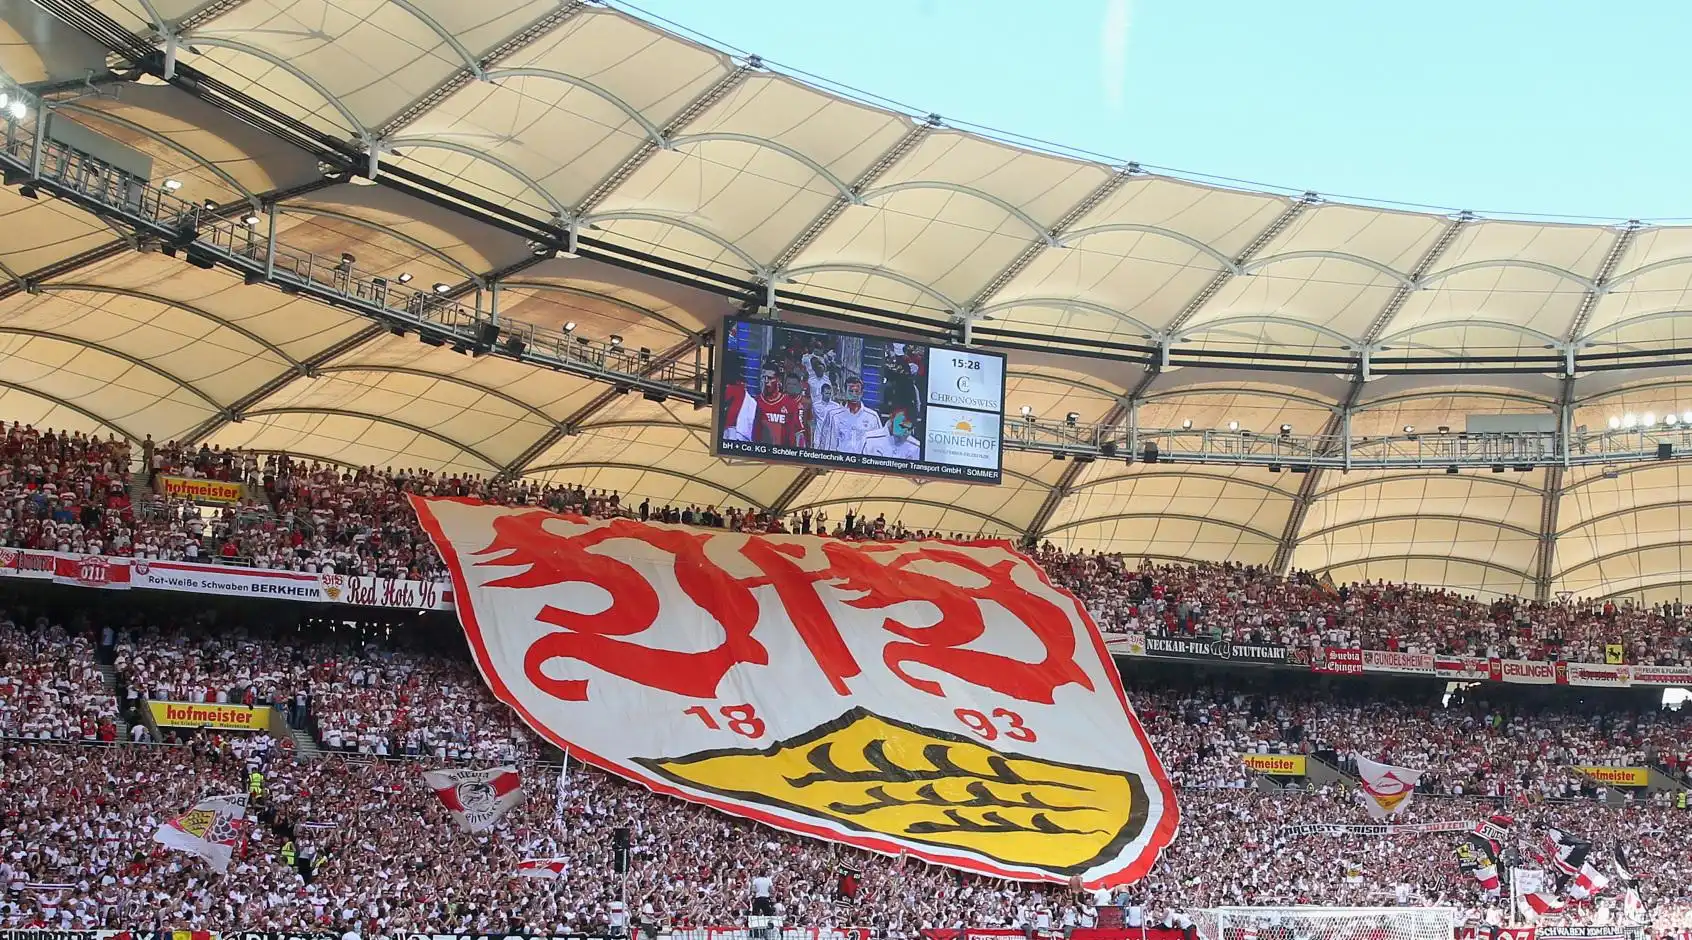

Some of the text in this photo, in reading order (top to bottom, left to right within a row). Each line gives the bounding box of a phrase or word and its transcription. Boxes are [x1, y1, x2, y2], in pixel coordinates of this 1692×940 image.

[951, 358, 980, 370] 15:28
[930, 391, 998, 408] CHRONOSWISS
[928, 433, 996, 450] SONNENHOF
[722, 441, 733, 450] bH
[741, 444, 753, 452] Co.
[754, 445, 767, 453] KG
[772, 447, 798, 456] Schöler
[798, 450, 844, 461] Fördertechnik
[910, 462, 940, 472] Transport
[941, 466, 962, 474] GmbH
[966, 468, 999, 478] SOMMER
[164, 479, 237, 498] hofmeister
[81, 565, 105, 580] 0711
[149, 575, 320, 598] Rot-Weiße Schwaben BERKHEIM
[347, 575, 436, 609] Red Hots 96
[1146, 638, 1286, 659] NECKAR-FILS STUTTGART
[1374, 655, 1423, 668] GUNDELSHEIM
[1503, 663, 1554, 677] GERLINGEN
[166, 704, 253, 723] hofmeister
[684, 703, 1037, 743] 18 93
[1244, 756, 1294, 770] ofmeister
[1539, 927, 1586, 937] SCHWABEN
